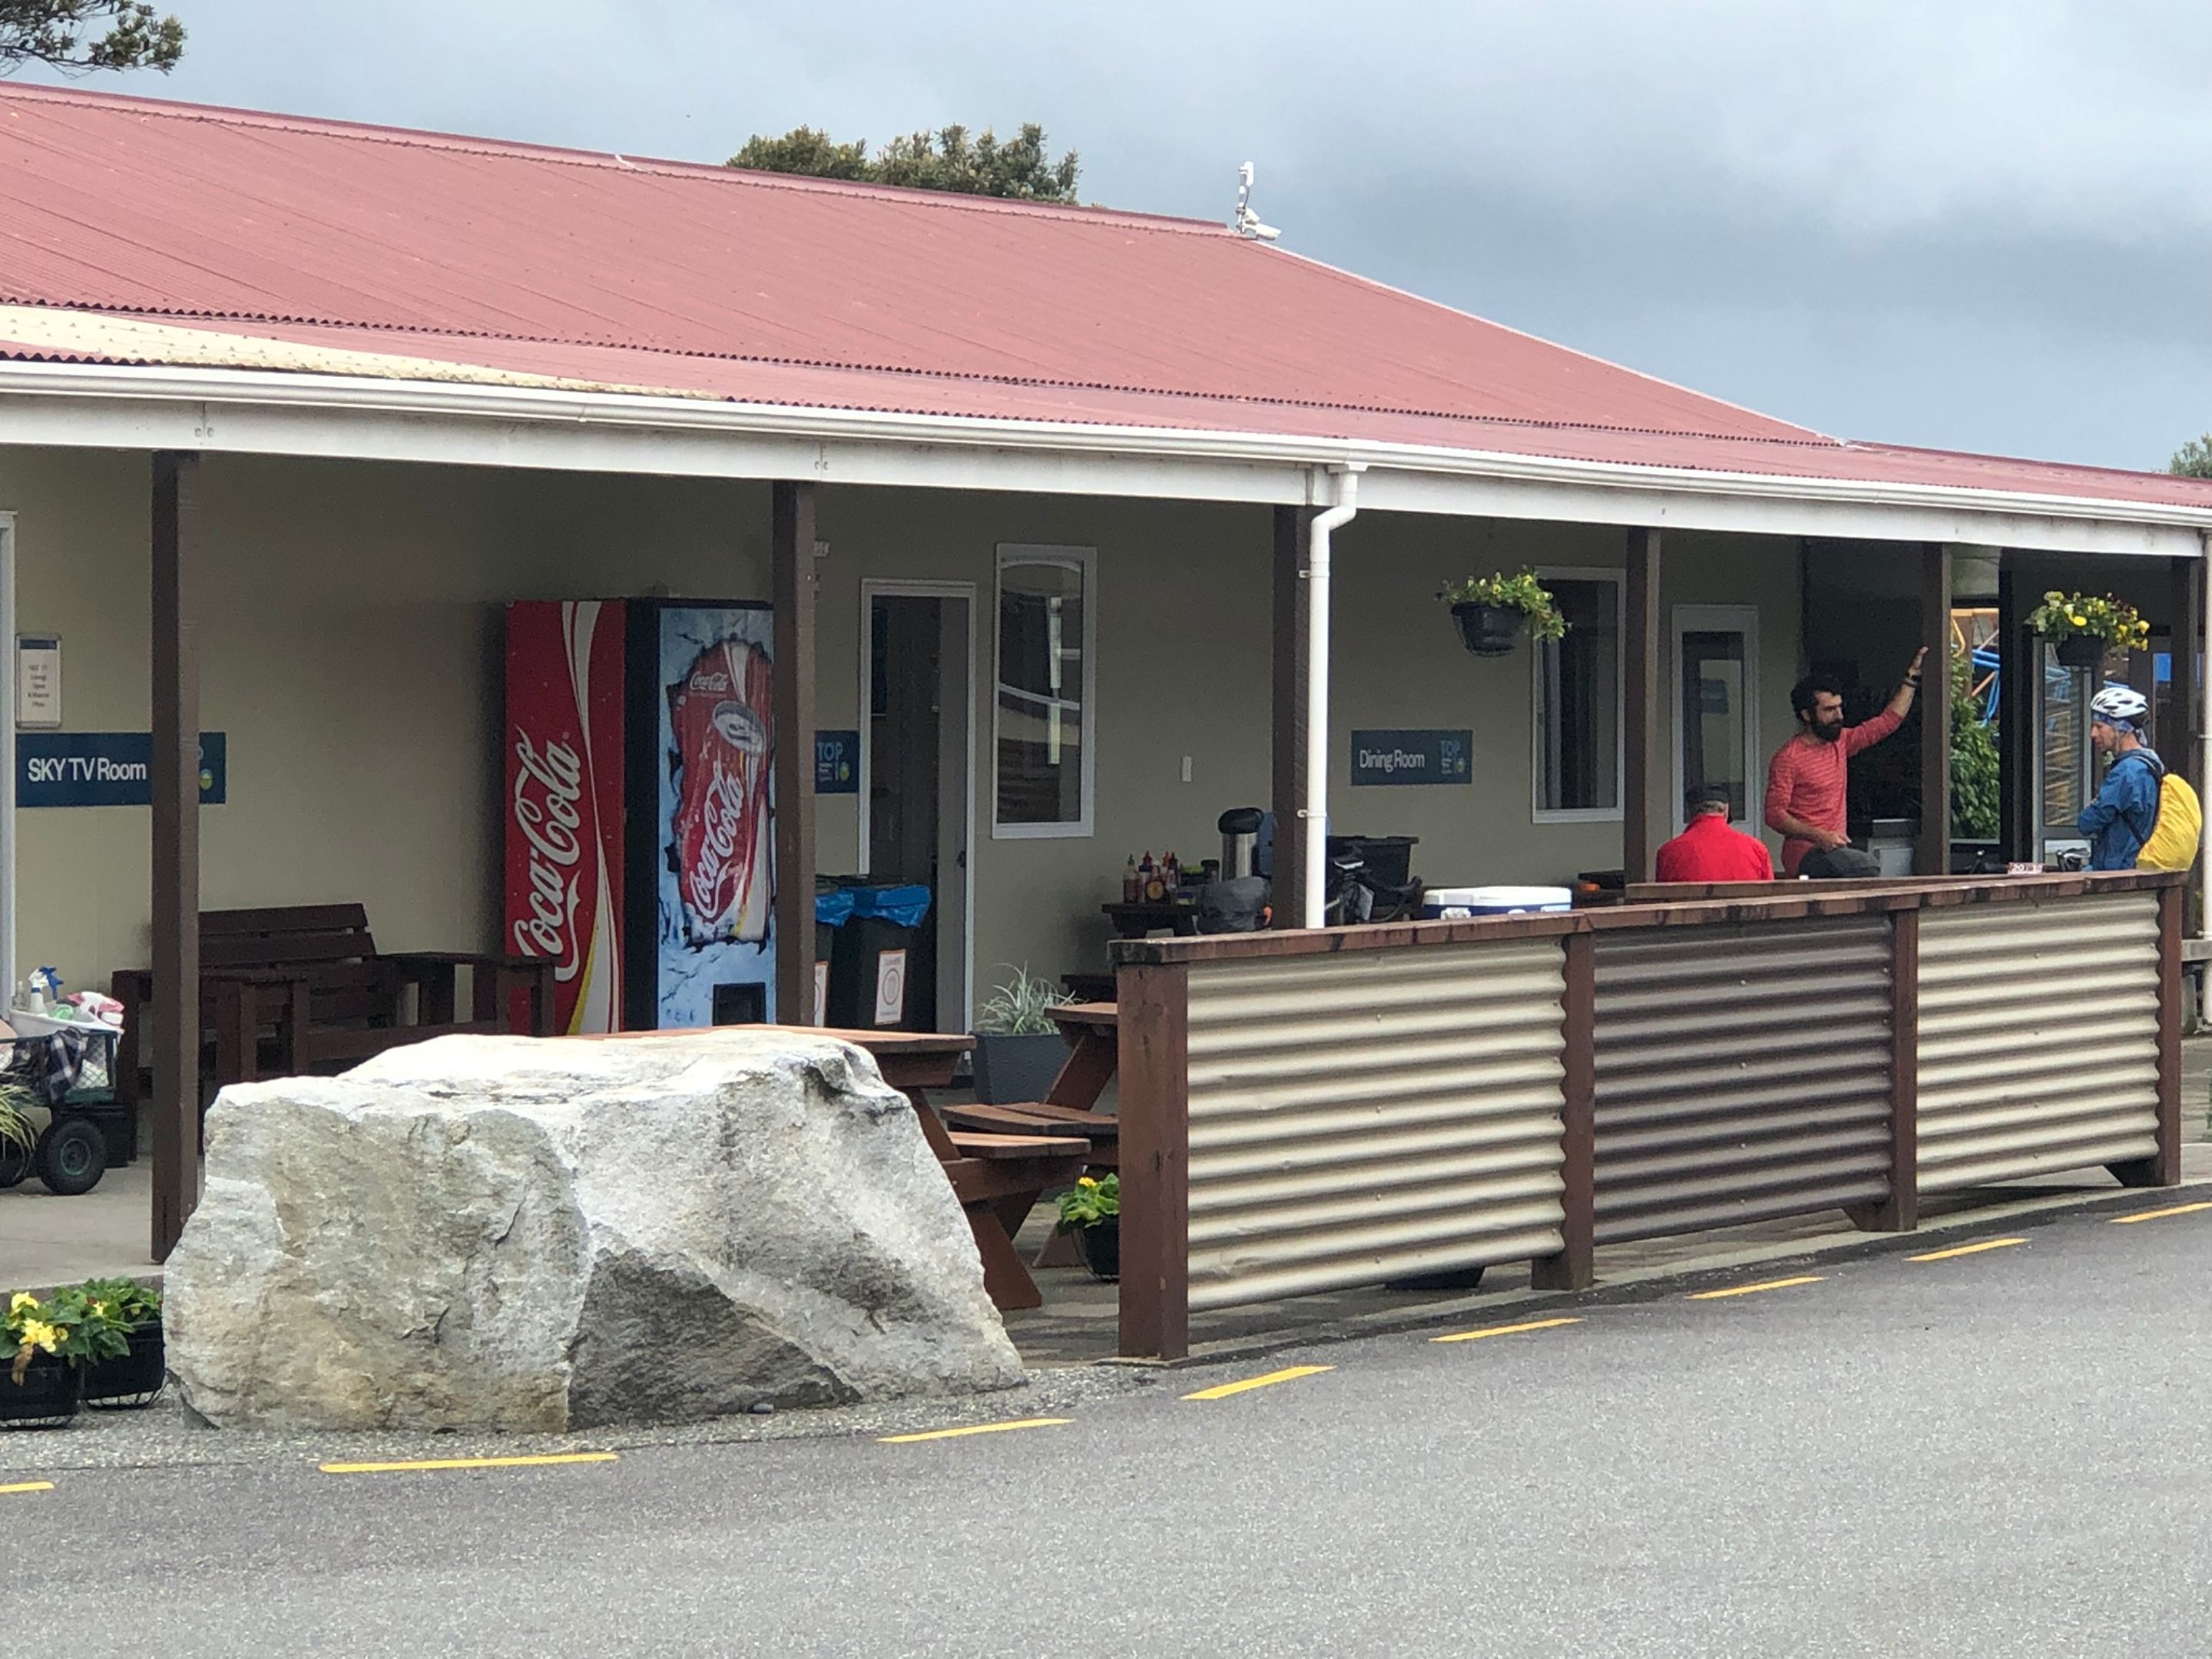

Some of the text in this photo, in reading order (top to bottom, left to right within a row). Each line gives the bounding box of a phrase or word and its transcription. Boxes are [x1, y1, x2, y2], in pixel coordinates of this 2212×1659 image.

[816, 741, 843, 762] TOP
[1359, 749, 1394, 773] Dining
[1394, 749, 1425, 768] Room
[28, 757, 147, 782] SKY TV Room
